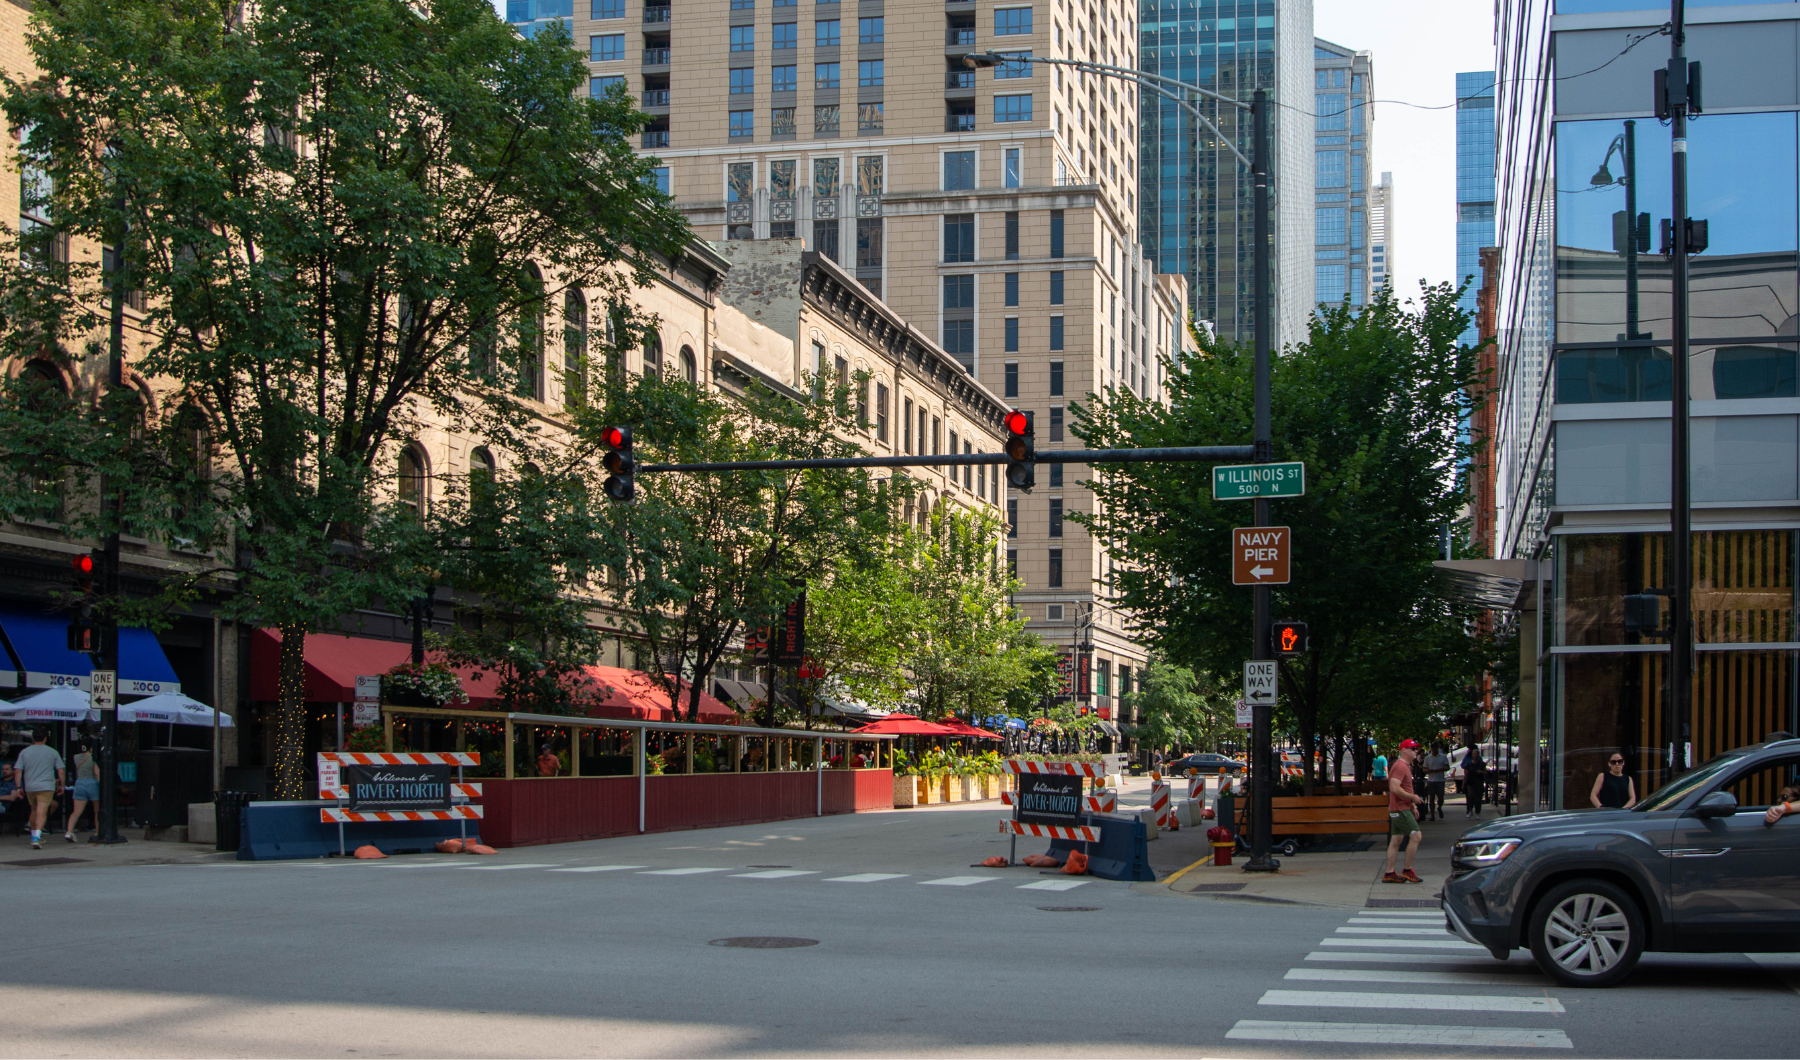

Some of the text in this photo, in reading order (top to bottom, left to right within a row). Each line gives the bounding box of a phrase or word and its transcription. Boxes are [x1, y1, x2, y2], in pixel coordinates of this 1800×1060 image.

[1218, 468, 1300, 483] W ILLINOIS ST
[1239, 483, 1279, 494] 500 N
[1240, 532, 1283, 546] NAVY
[1244, 548, 1278, 562] PIER
[787, 601, 798, 616] NO
[786, 619, 797, 652] RIGHT
[1248, 664, 1273, 676] ONE
[50, 675, 80, 687] XOCO
[93, 673, 113, 684] ONE
[1065, 657, 1073, 697] NORTH
[1248, 676, 1273, 688] WAY
[93, 684, 113, 694] WAY
[133, 681, 160, 692] XOCO
[53, 710, 78, 718] TEQUILA
[372, 771, 435, 782] Welcome to
[356, 782, 444, 799] RIVER NORTH
[1032, 781, 1073, 794] Welcome to
[1022, 793, 1078, 813] RIVER NORTH
